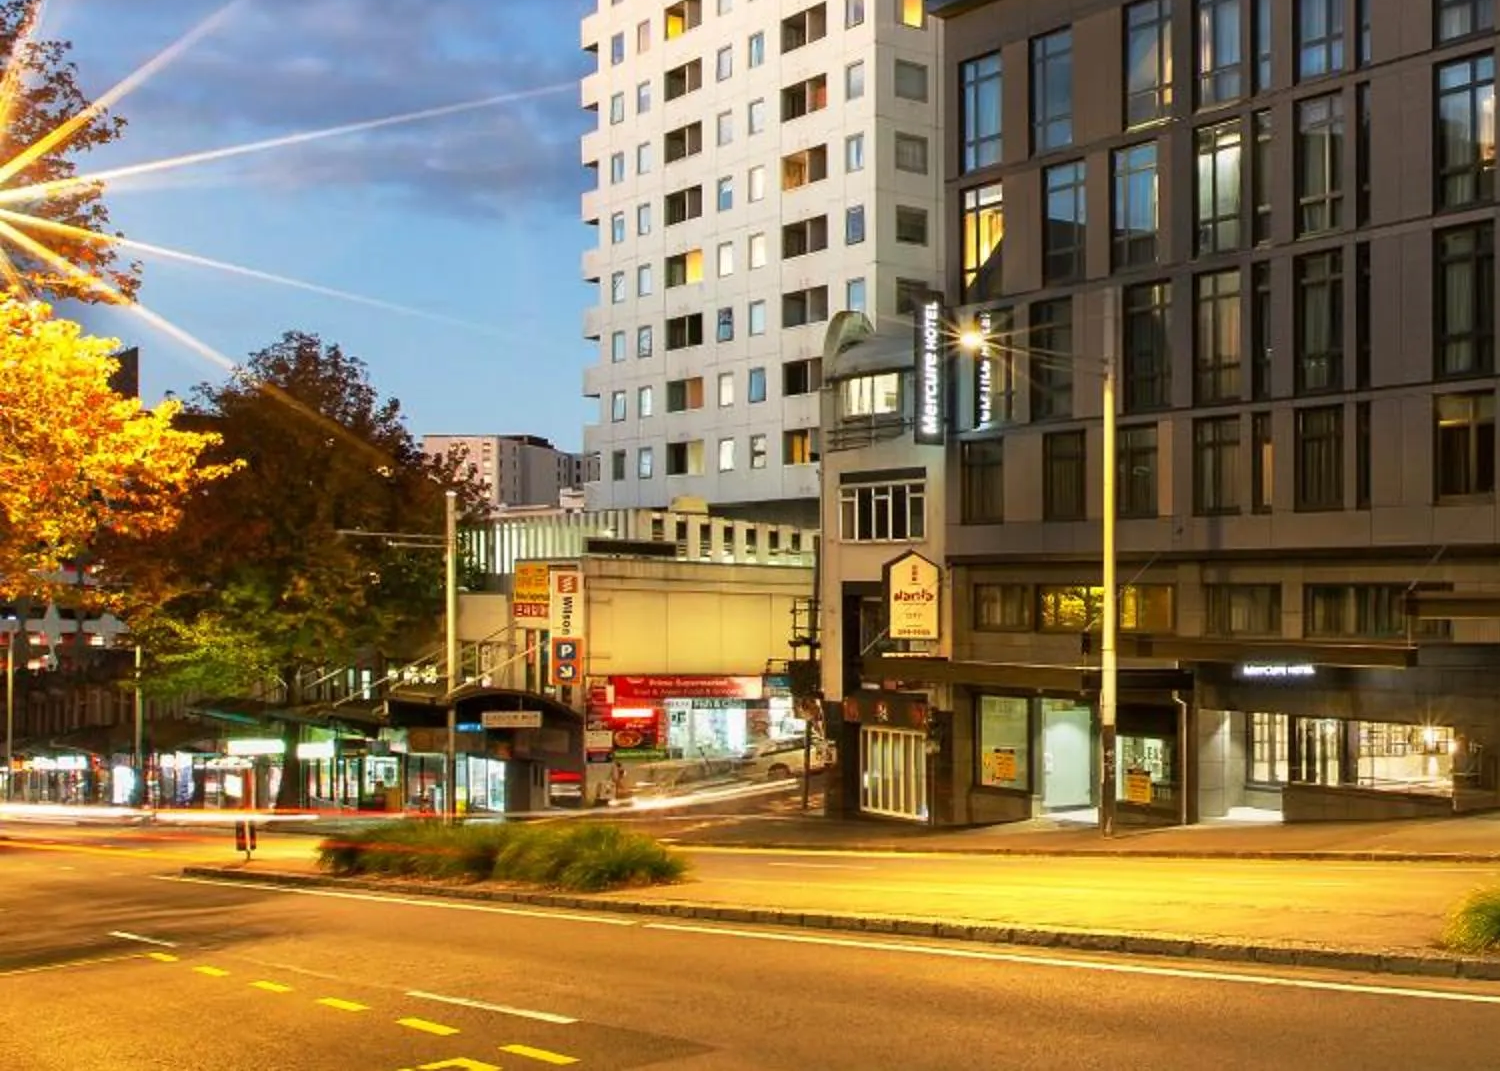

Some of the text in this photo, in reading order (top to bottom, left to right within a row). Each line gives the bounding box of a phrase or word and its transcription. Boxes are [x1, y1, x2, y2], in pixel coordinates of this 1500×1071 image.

[921, 300, 939, 435] Mercure HOTEL
[561, 596, 574, 636] Wilson
[560, 644, 573, 658] P
